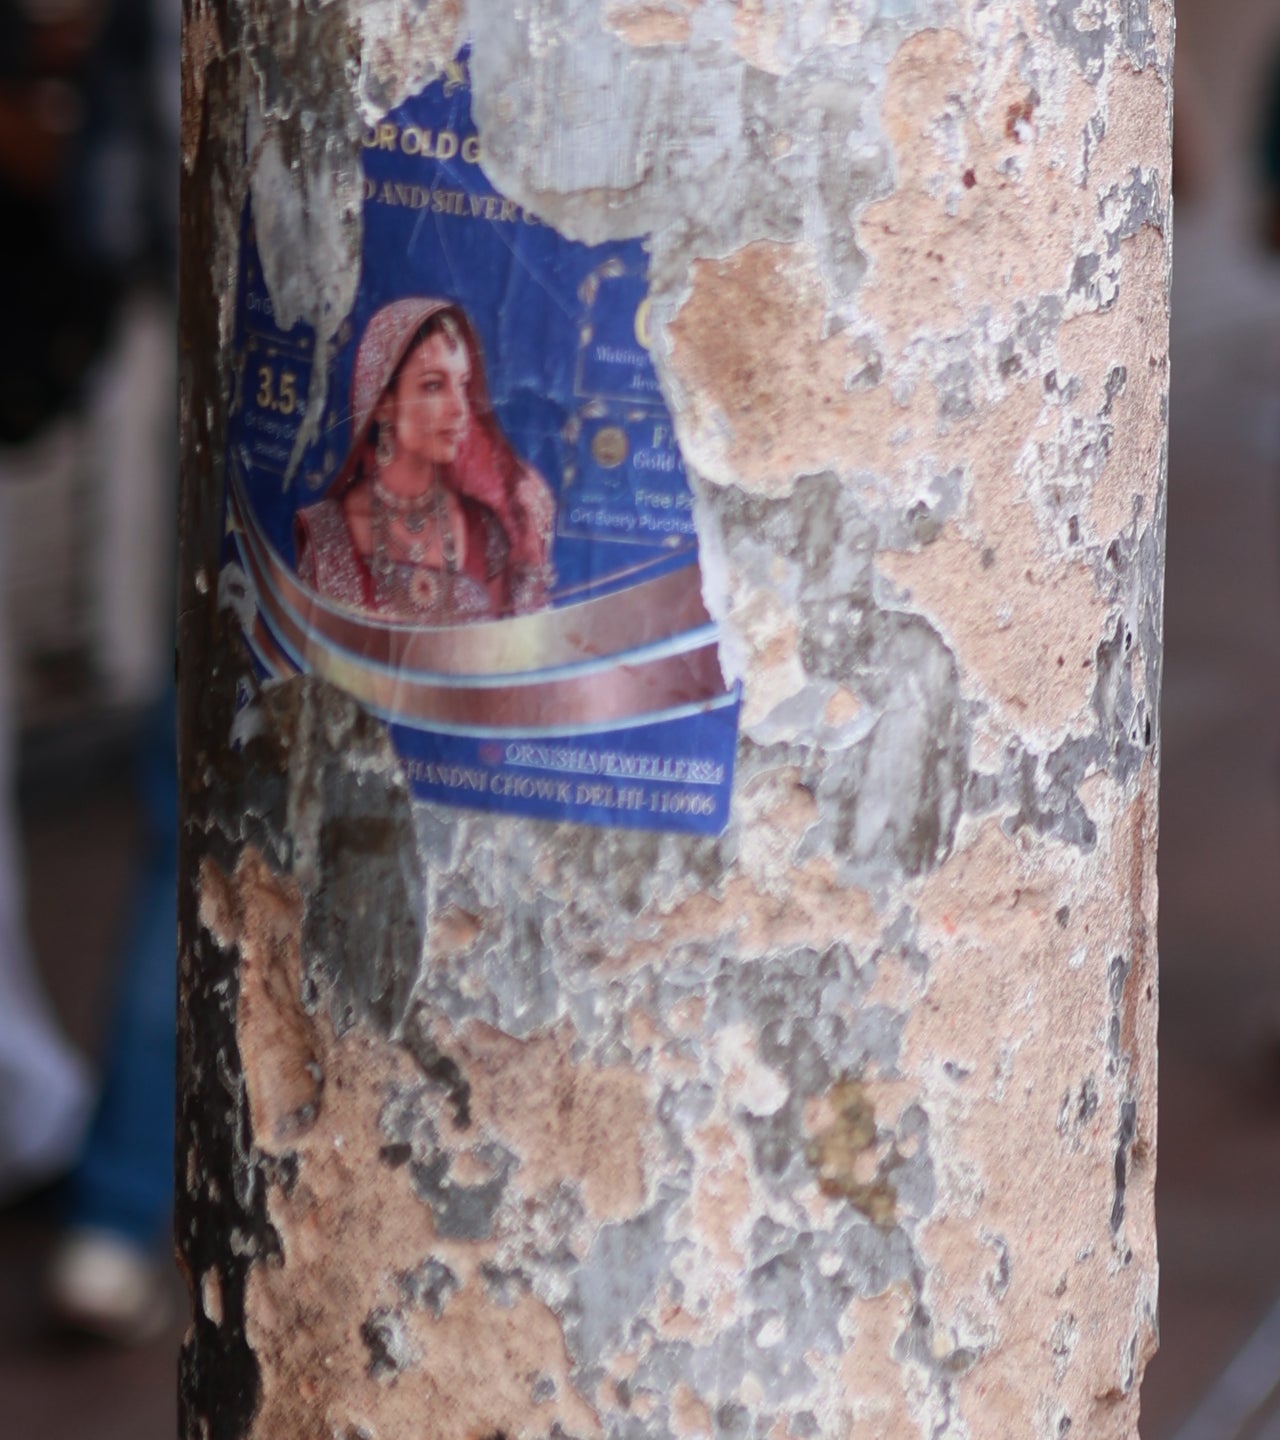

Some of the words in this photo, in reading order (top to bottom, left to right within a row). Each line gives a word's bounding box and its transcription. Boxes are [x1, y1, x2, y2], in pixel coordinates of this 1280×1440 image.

[401, 127, 458, 160] OLD
[378, 181, 430, 208] AND
[431, 190, 519, 224] SILVER
[635, 488, 671, 509] Free
[406, 759, 489, 792] HANDNI
[490, 773, 572, 804] CHOWK
[576, 783, 717, 817] DELHI-110006
